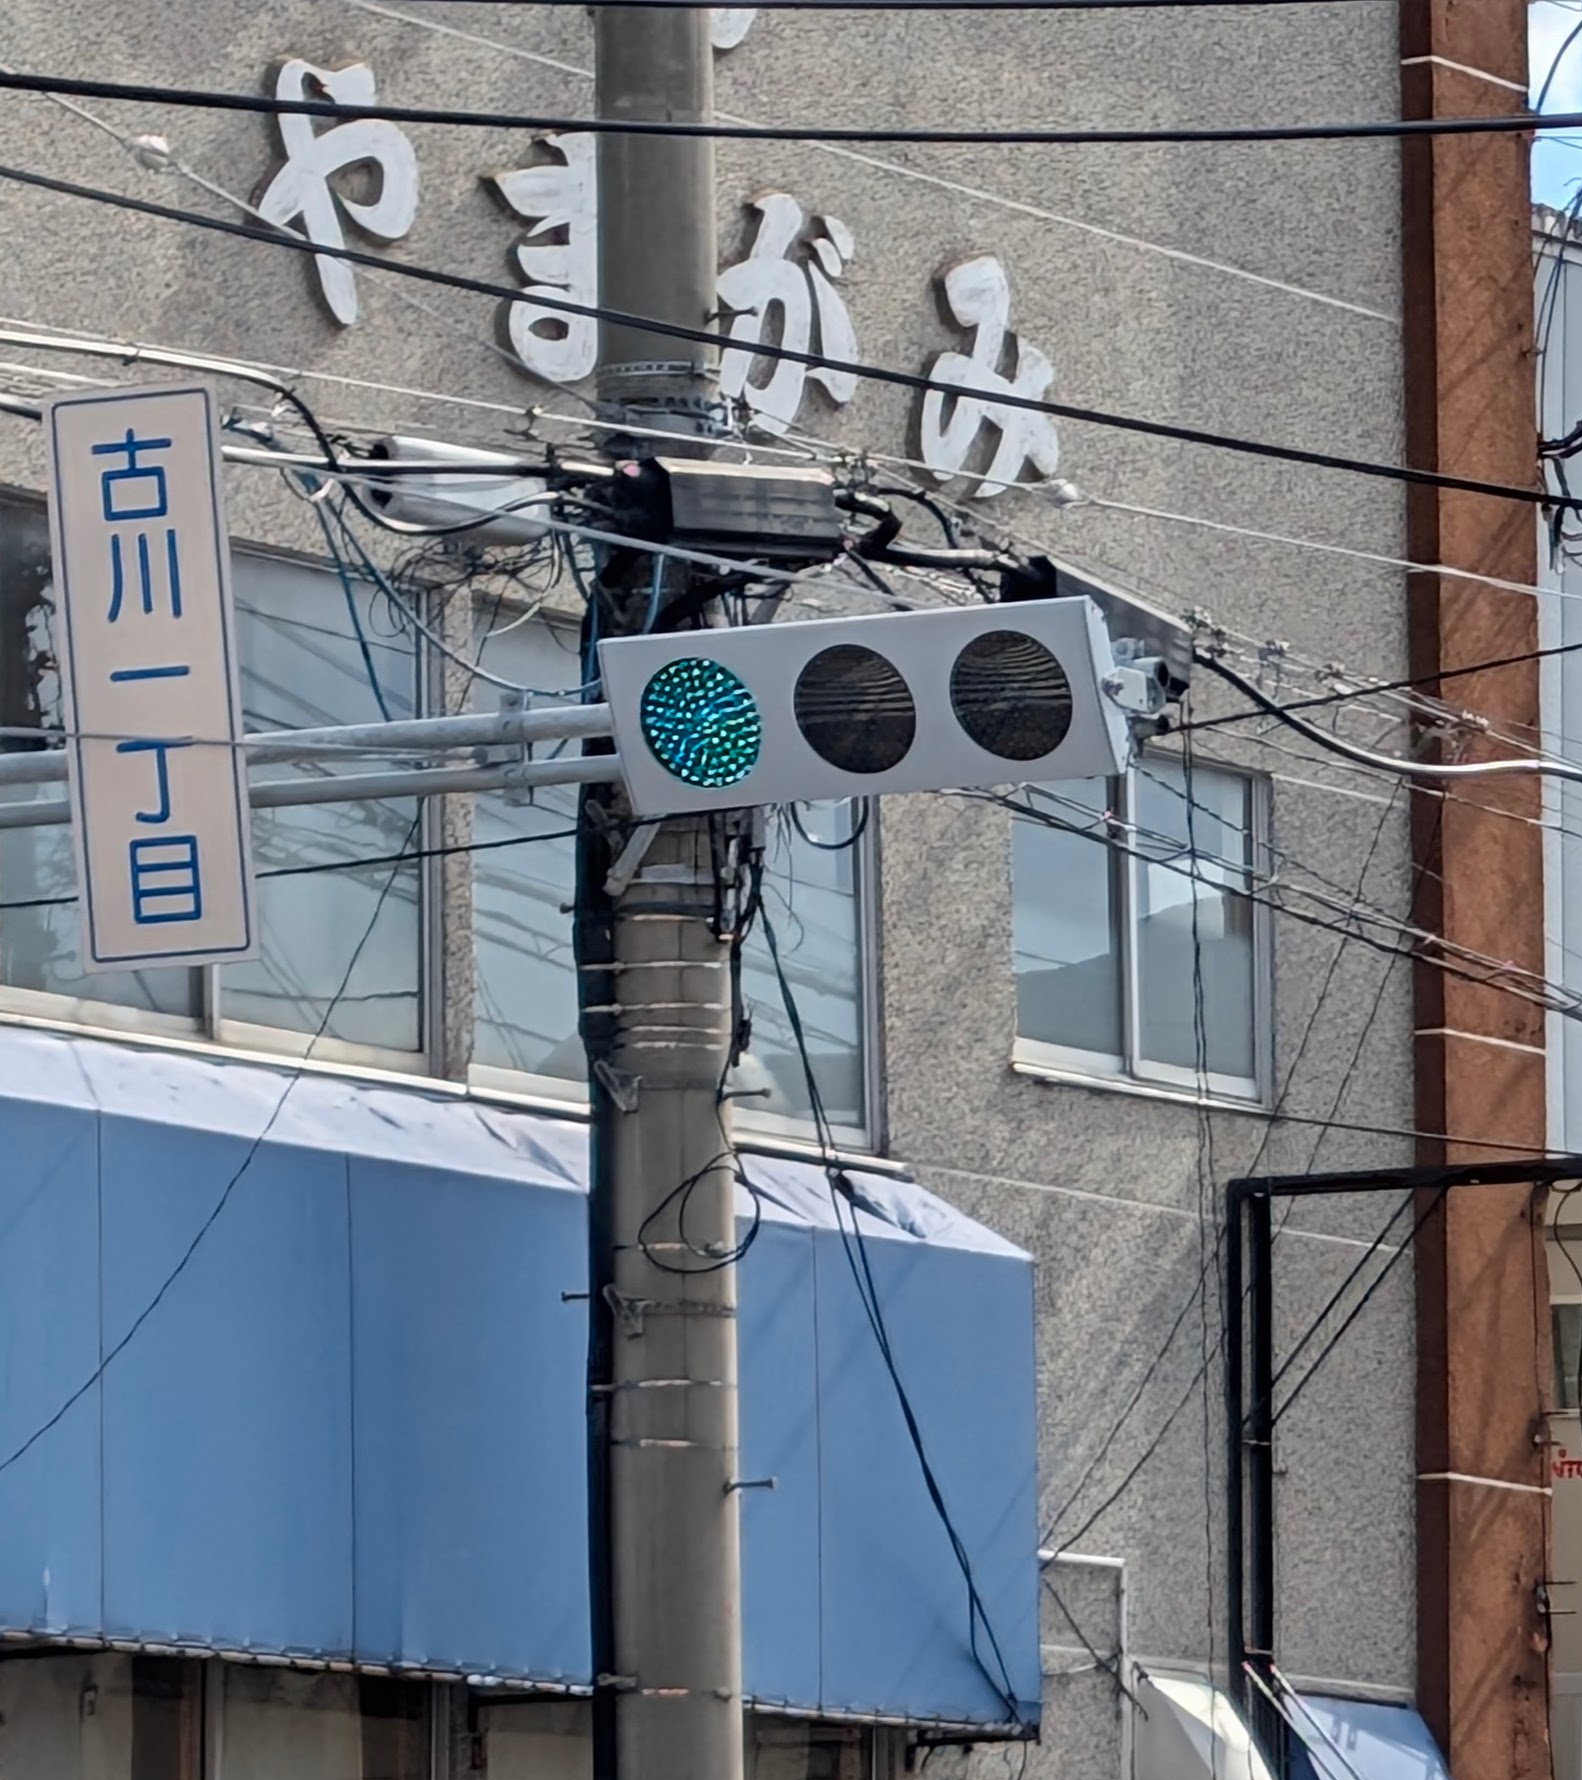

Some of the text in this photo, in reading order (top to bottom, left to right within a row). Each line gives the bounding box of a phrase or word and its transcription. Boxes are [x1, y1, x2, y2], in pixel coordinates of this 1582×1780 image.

[92, 428, 204, 926] 古川一丁目
